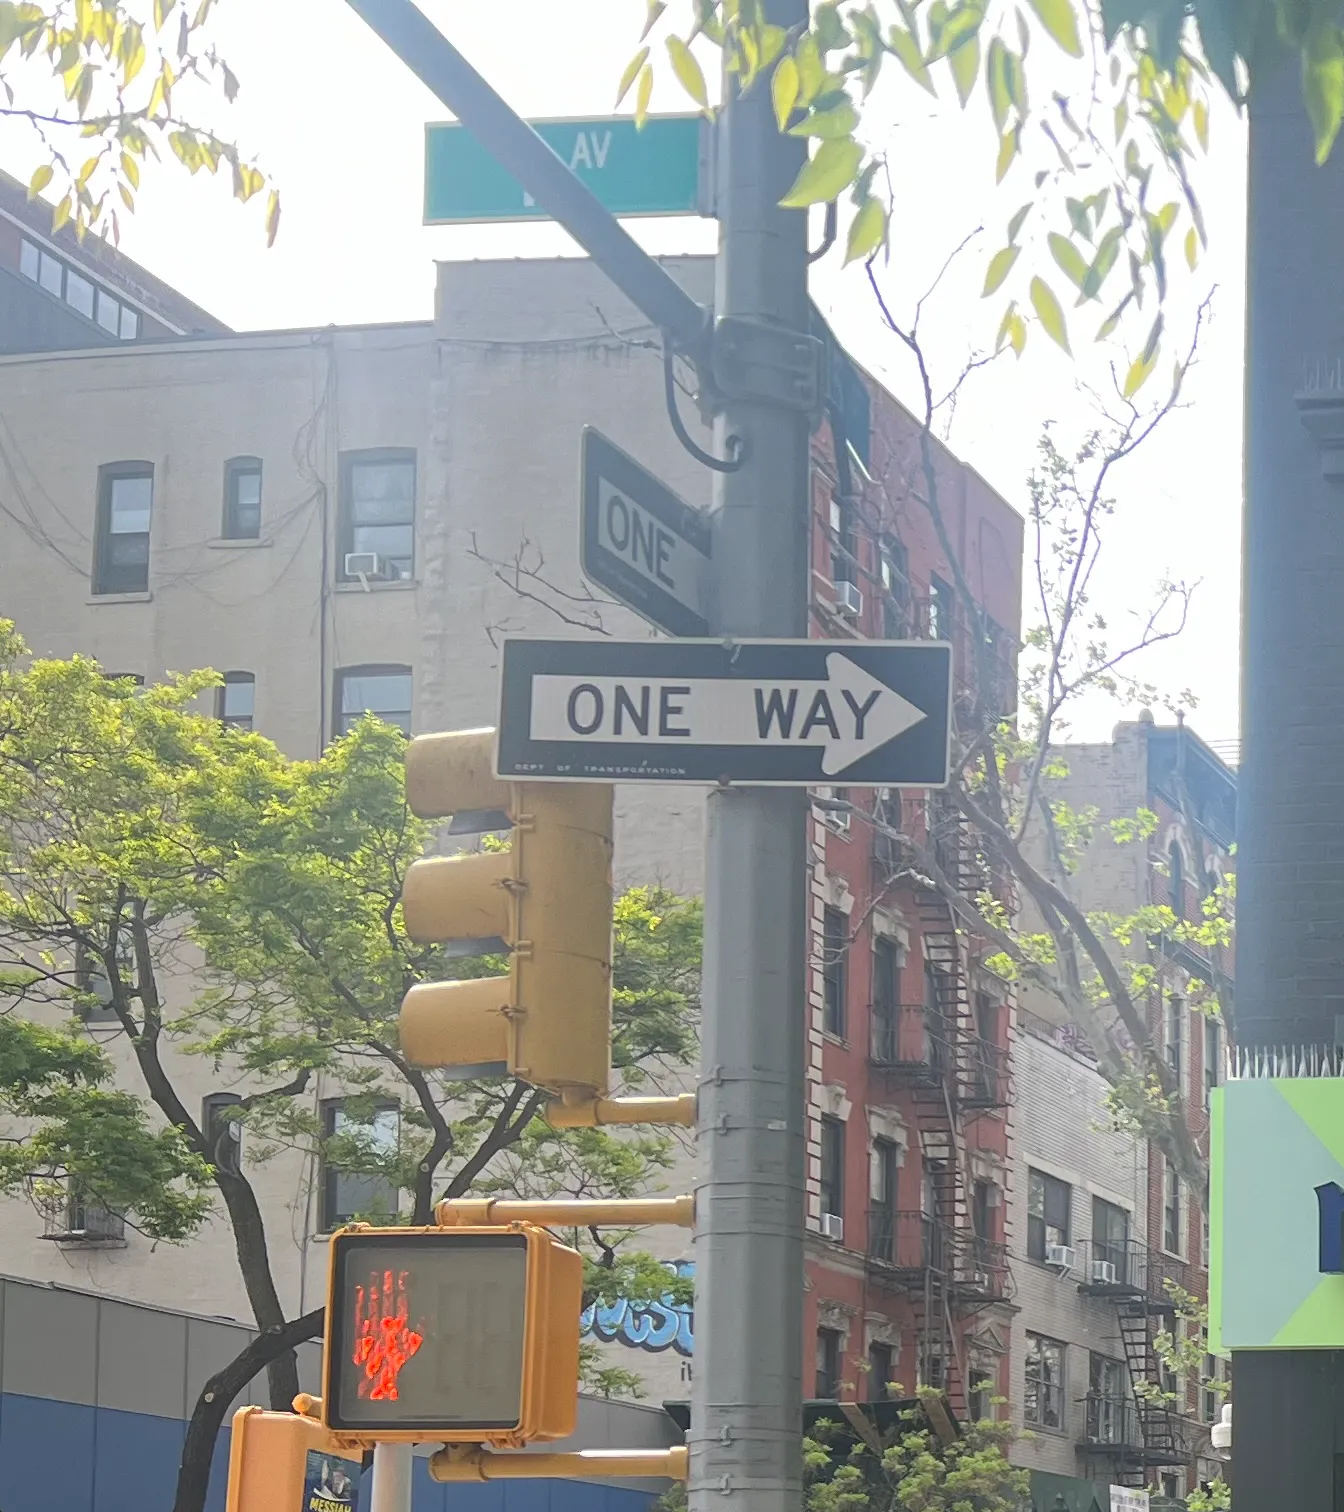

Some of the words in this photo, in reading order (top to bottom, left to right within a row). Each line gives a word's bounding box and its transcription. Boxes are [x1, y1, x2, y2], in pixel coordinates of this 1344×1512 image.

[570, 131, 611, 170] AV
[607, 496, 675, 589] ONE
[567, 684, 691, 737] ONE
[754, 688, 882, 740] WAY
